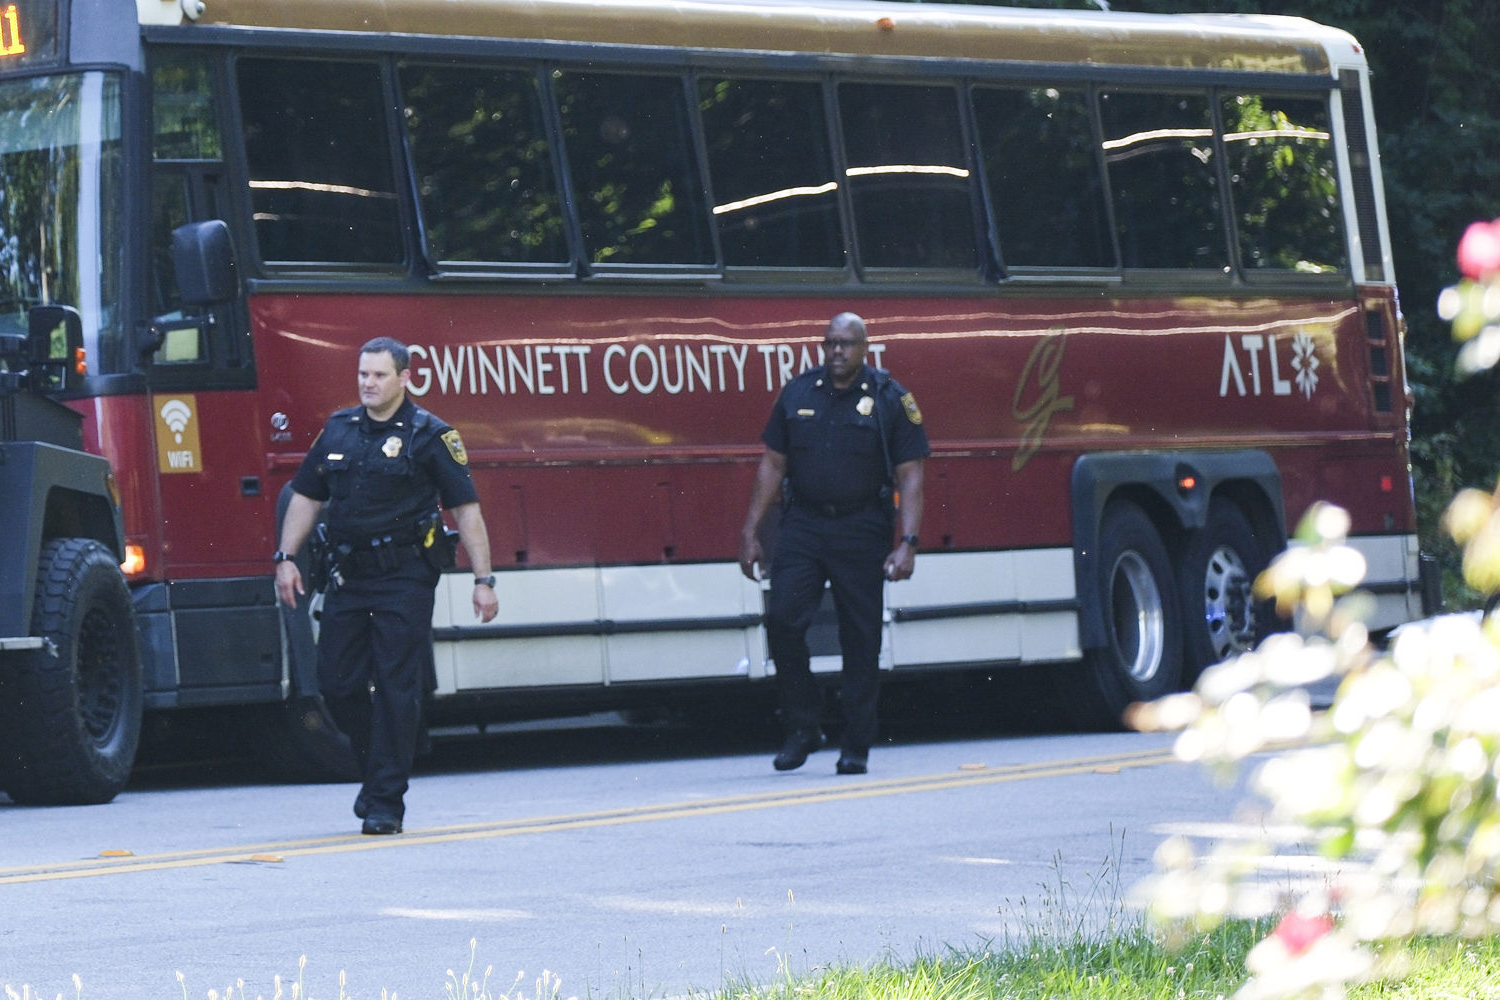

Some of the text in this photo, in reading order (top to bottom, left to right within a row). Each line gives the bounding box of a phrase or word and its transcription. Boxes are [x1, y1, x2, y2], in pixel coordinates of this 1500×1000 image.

[407, 344, 592, 396] GWINNETT
[603, 343, 748, 395] COUNTY
[1220, 333, 1291, 396] ATL
